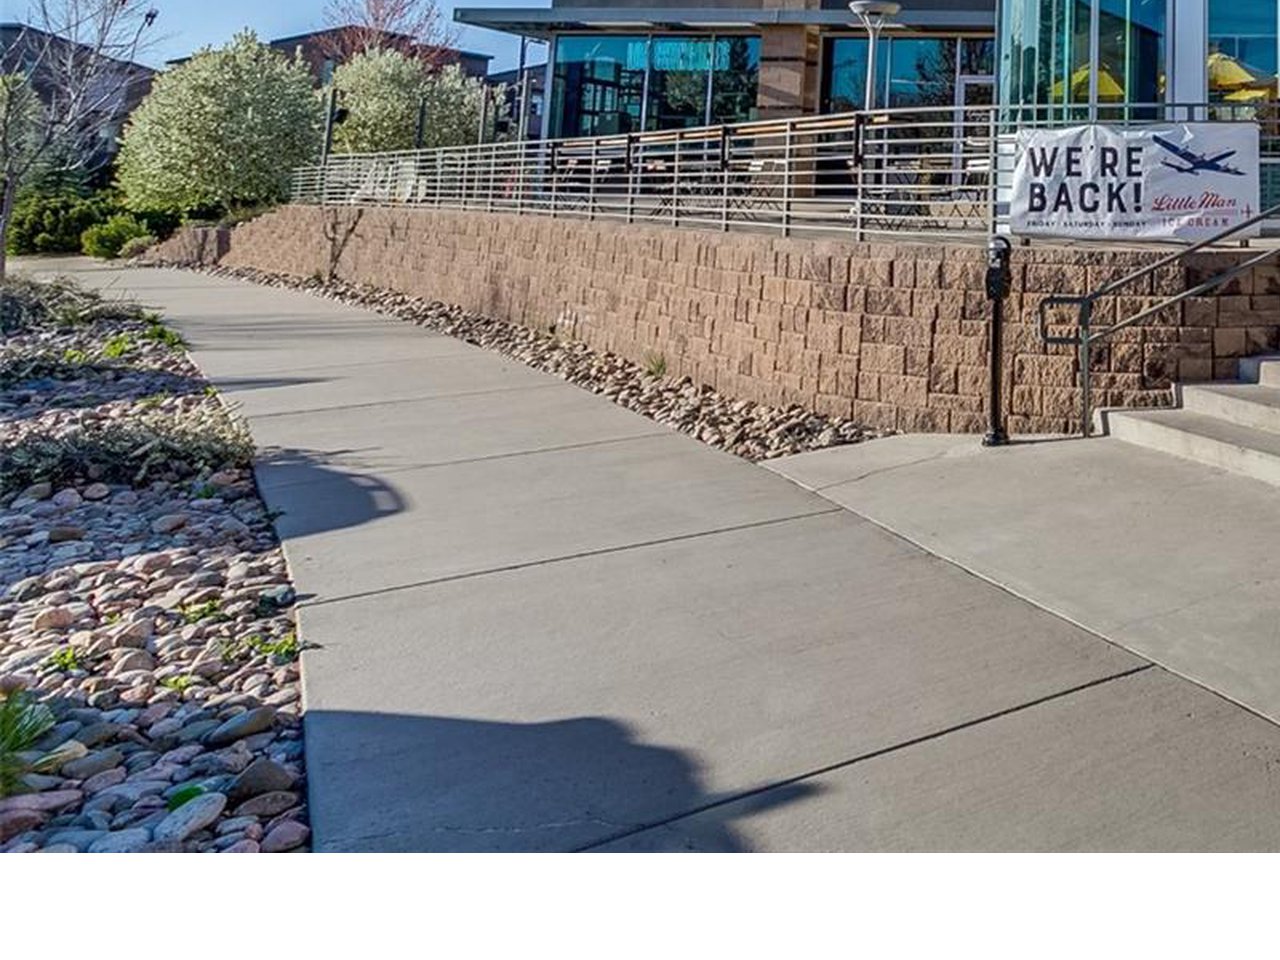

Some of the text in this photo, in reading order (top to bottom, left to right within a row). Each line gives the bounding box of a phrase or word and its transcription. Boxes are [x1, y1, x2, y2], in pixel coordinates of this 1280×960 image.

[1029, 145, 1143, 177] WE'RE
[1029, 182, 1142, 213] BACK!
[1152, 190, 1237, 212] Little Man
[1026, 220, 1056, 228] FRIDAY
[1062, 220, 1105, 228] SATURDAY
[1186, 217, 1230, 228] CREAM
